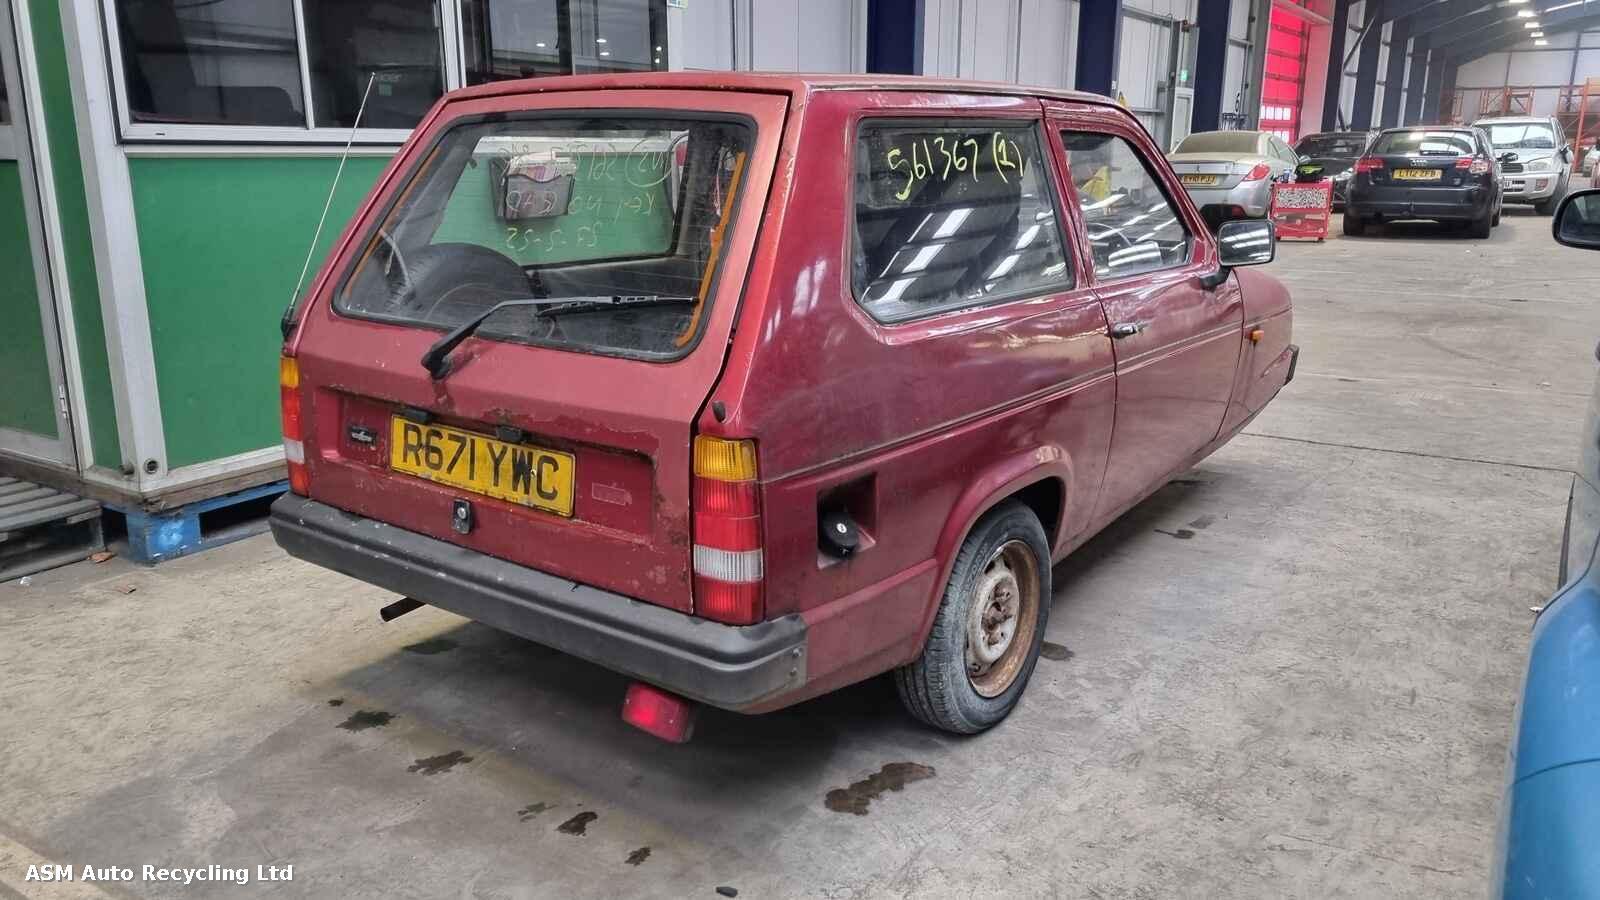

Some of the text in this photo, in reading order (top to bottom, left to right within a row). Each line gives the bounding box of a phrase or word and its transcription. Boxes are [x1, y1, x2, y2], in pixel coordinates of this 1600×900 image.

[887, 136, 978, 200] 561367
[402, 423, 560, 500] R671 YWC
